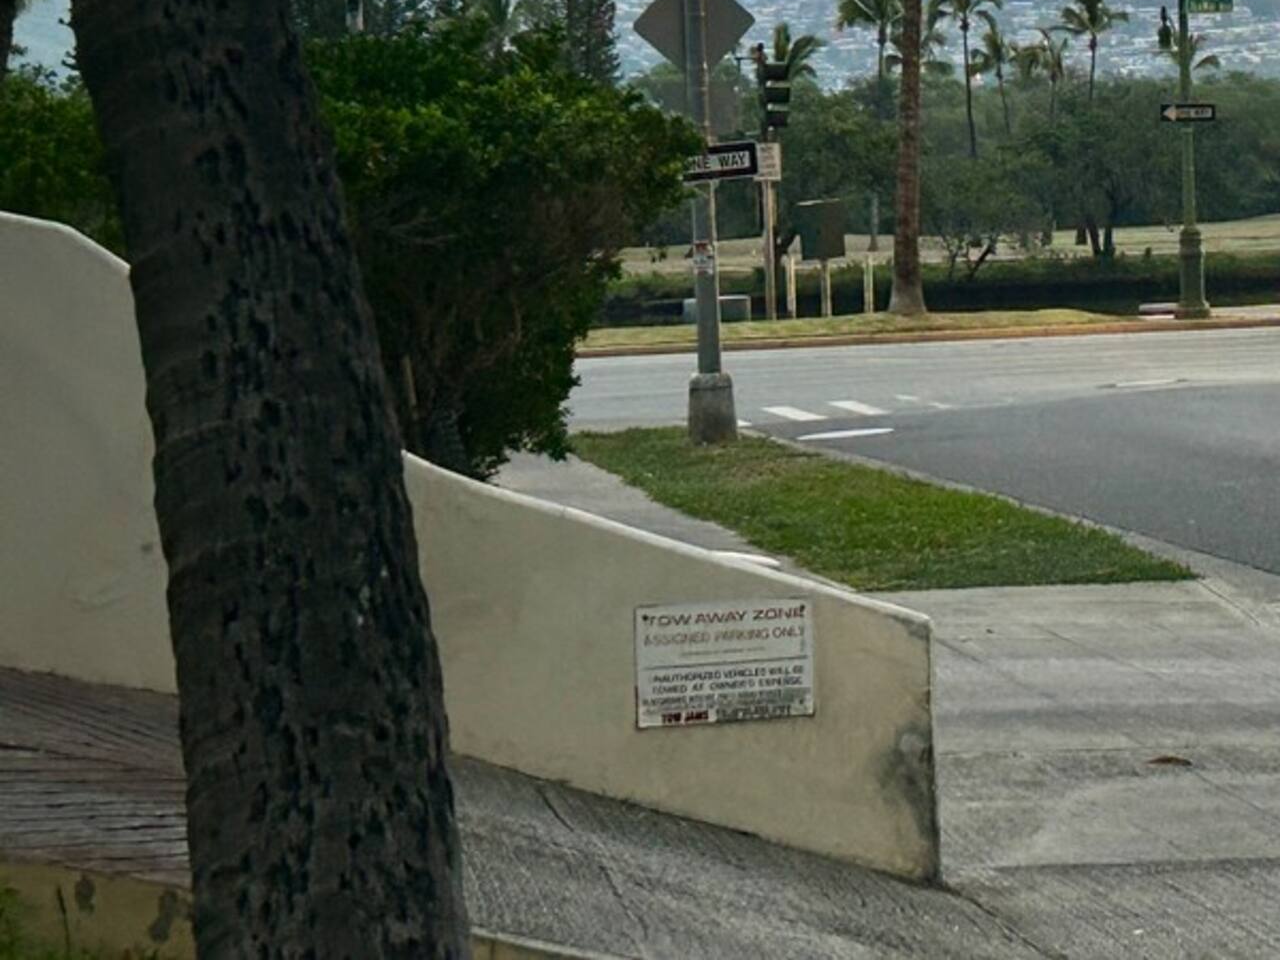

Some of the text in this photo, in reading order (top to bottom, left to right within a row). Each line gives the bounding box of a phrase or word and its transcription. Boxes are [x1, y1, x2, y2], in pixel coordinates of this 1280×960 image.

[719, 152, 746, 167] WAY
[646, 607, 805, 626] TOW AWAY ZONE
[649, 669, 721, 683] NAUTHORIZED
